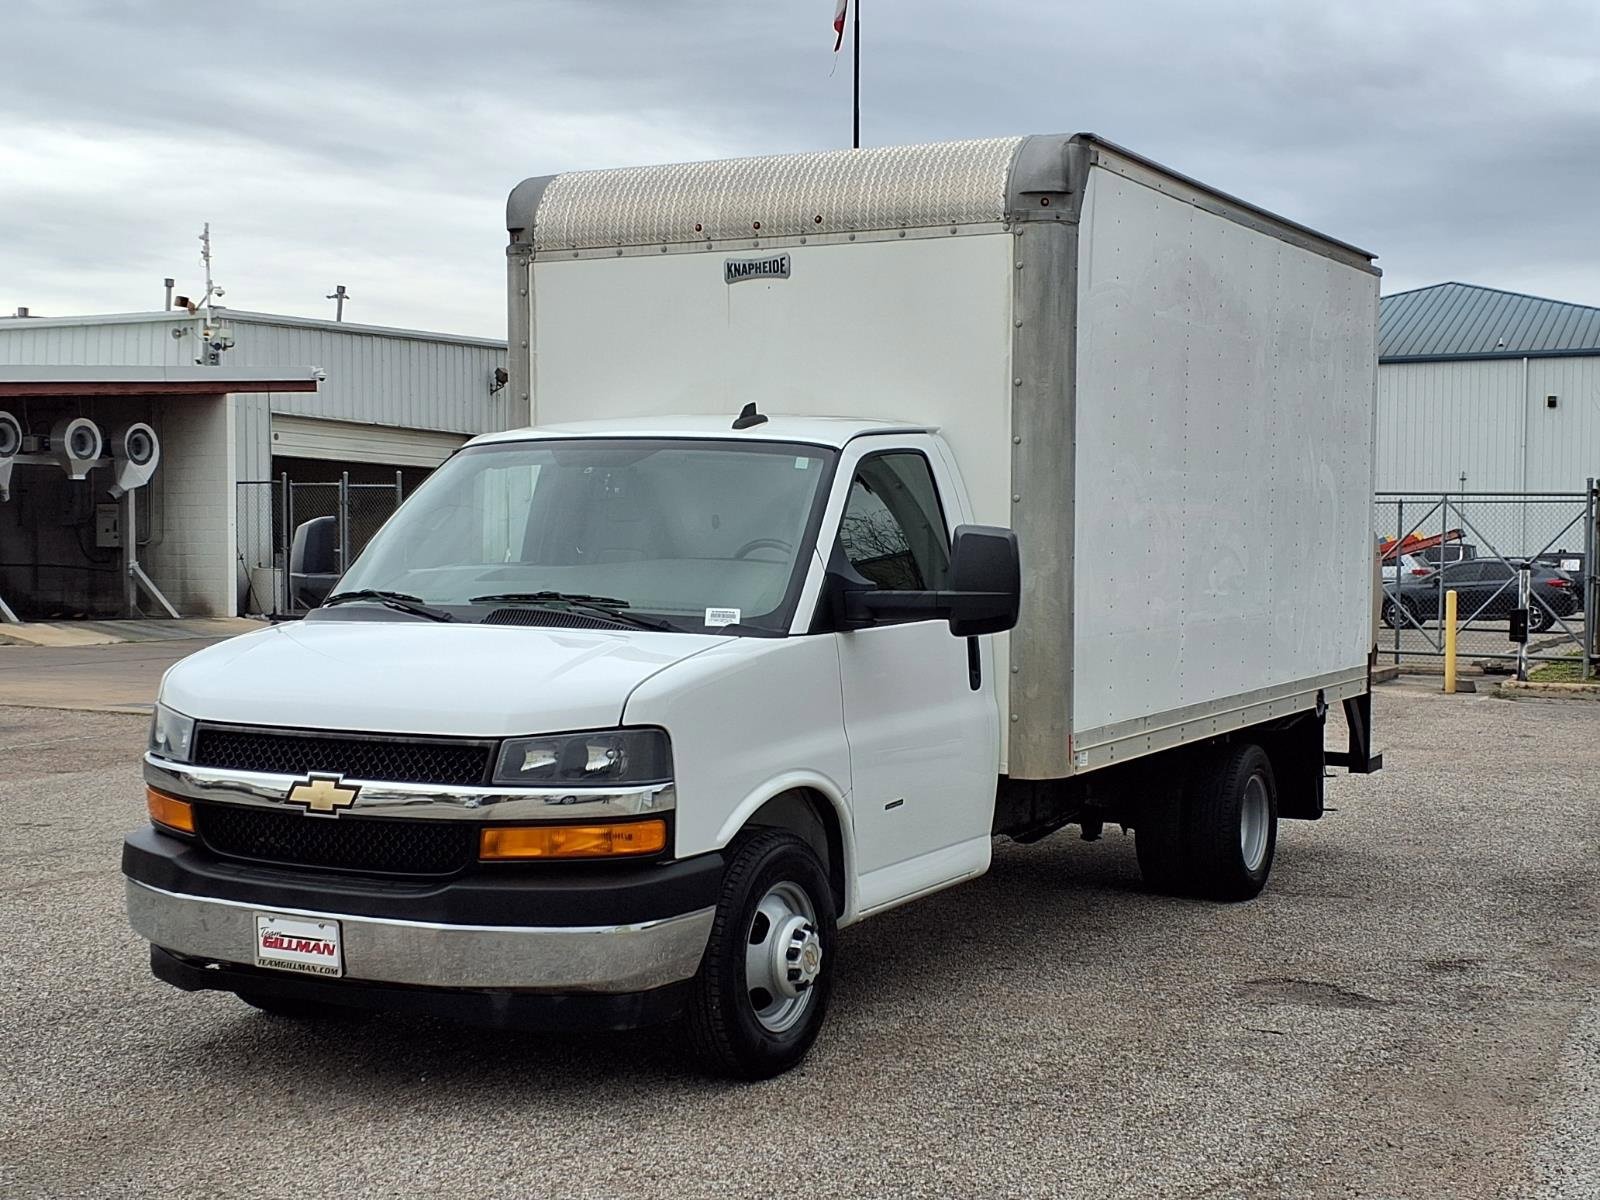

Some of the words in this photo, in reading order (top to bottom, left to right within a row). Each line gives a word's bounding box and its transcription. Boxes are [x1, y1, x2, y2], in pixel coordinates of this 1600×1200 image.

[726, 257, 787, 280] KNAPHEIDE
[260, 927, 282, 938] Team
[262, 935, 336, 956] GILLMAN
[257, 958, 339, 976] TEAMGILLMAN.COM
